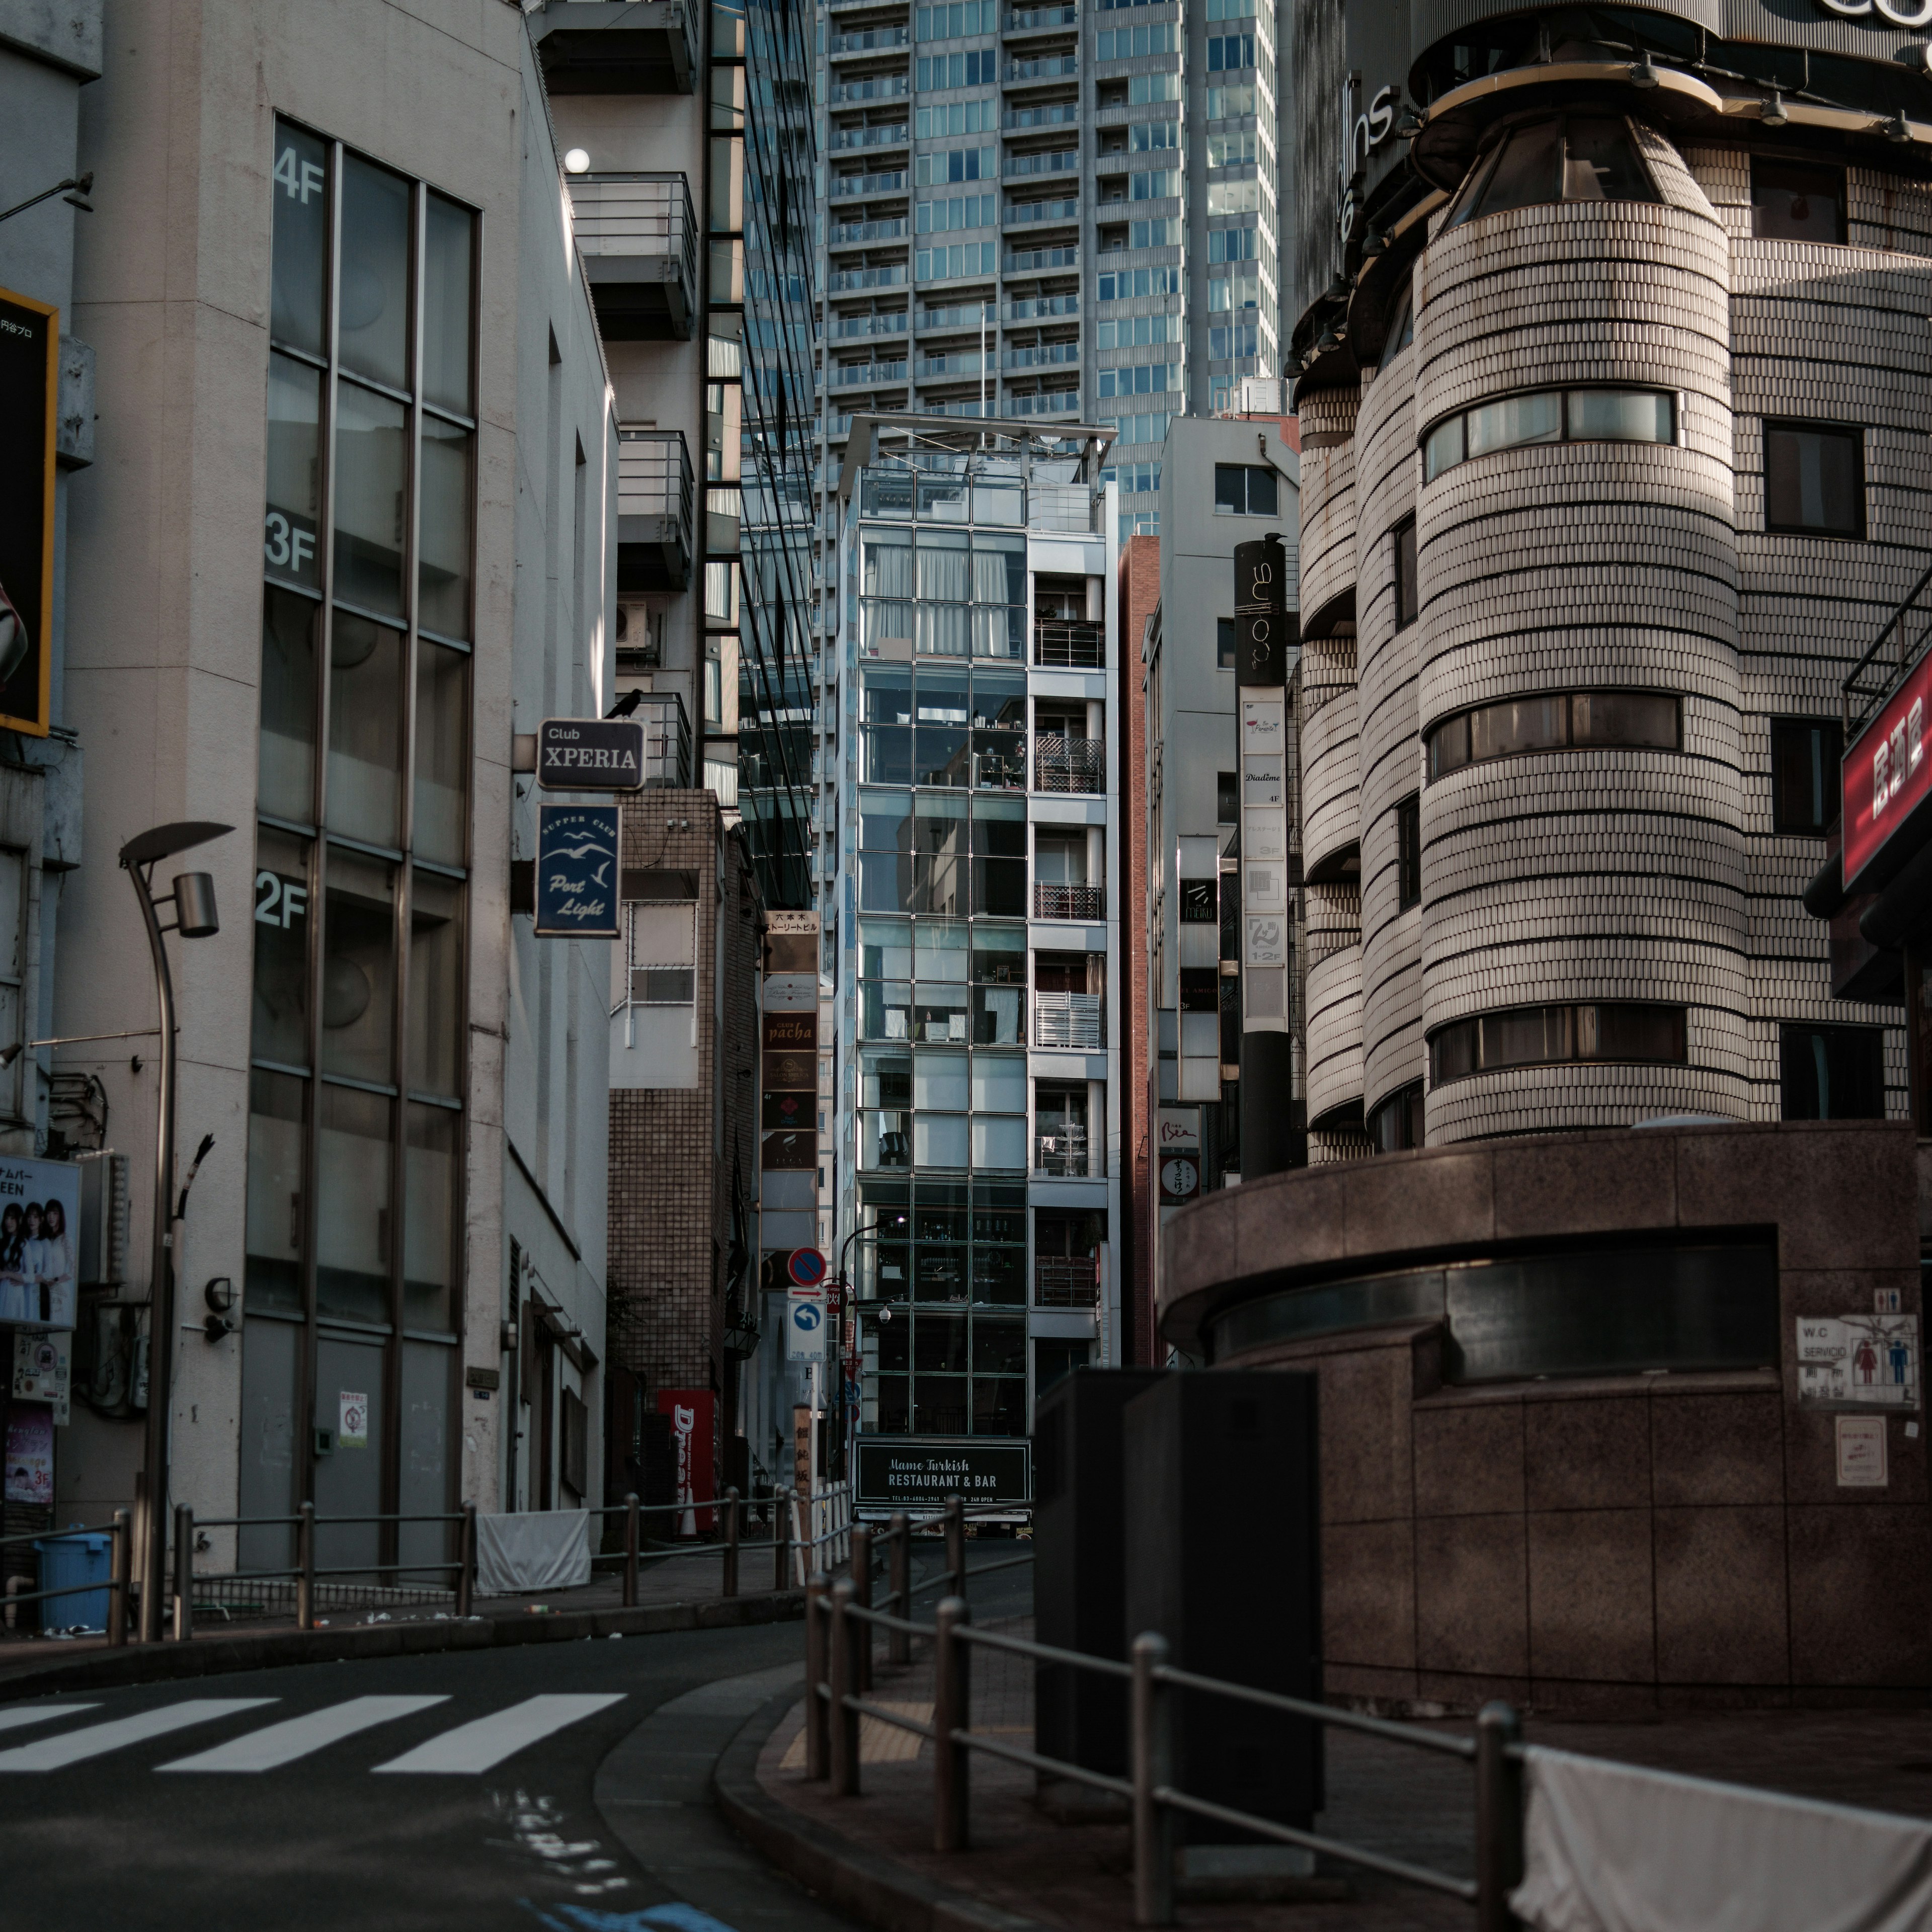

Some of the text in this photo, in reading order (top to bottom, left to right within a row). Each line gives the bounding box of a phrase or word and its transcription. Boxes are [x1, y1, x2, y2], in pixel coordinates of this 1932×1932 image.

[274, 147, 324, 204] 4F
[265, 512, 315, 572] 3F
[549, 728, 580, 740] Club
[545, 747, 637, 769] XPERIA
[1873, 696, 1923, 820] 居酒屋
[543, 816, 616, 837] SUPPER CLUB
[1260, 846, 1280, 854] 3F
[549, 874, 586, 894] Port
[255, 871, 307, 929] 2F
[557, 898, 605, 921] Light
[1252, 952, 1281, 960] 1-2F
[769, 1022, 813, 1042] pacha
[889, 1459, 970, 1471] Mamo Turkish
[35, 1470, 50, 1485] 3F
[889, 1474, 997, 1487] RESTAURANT & BAR
